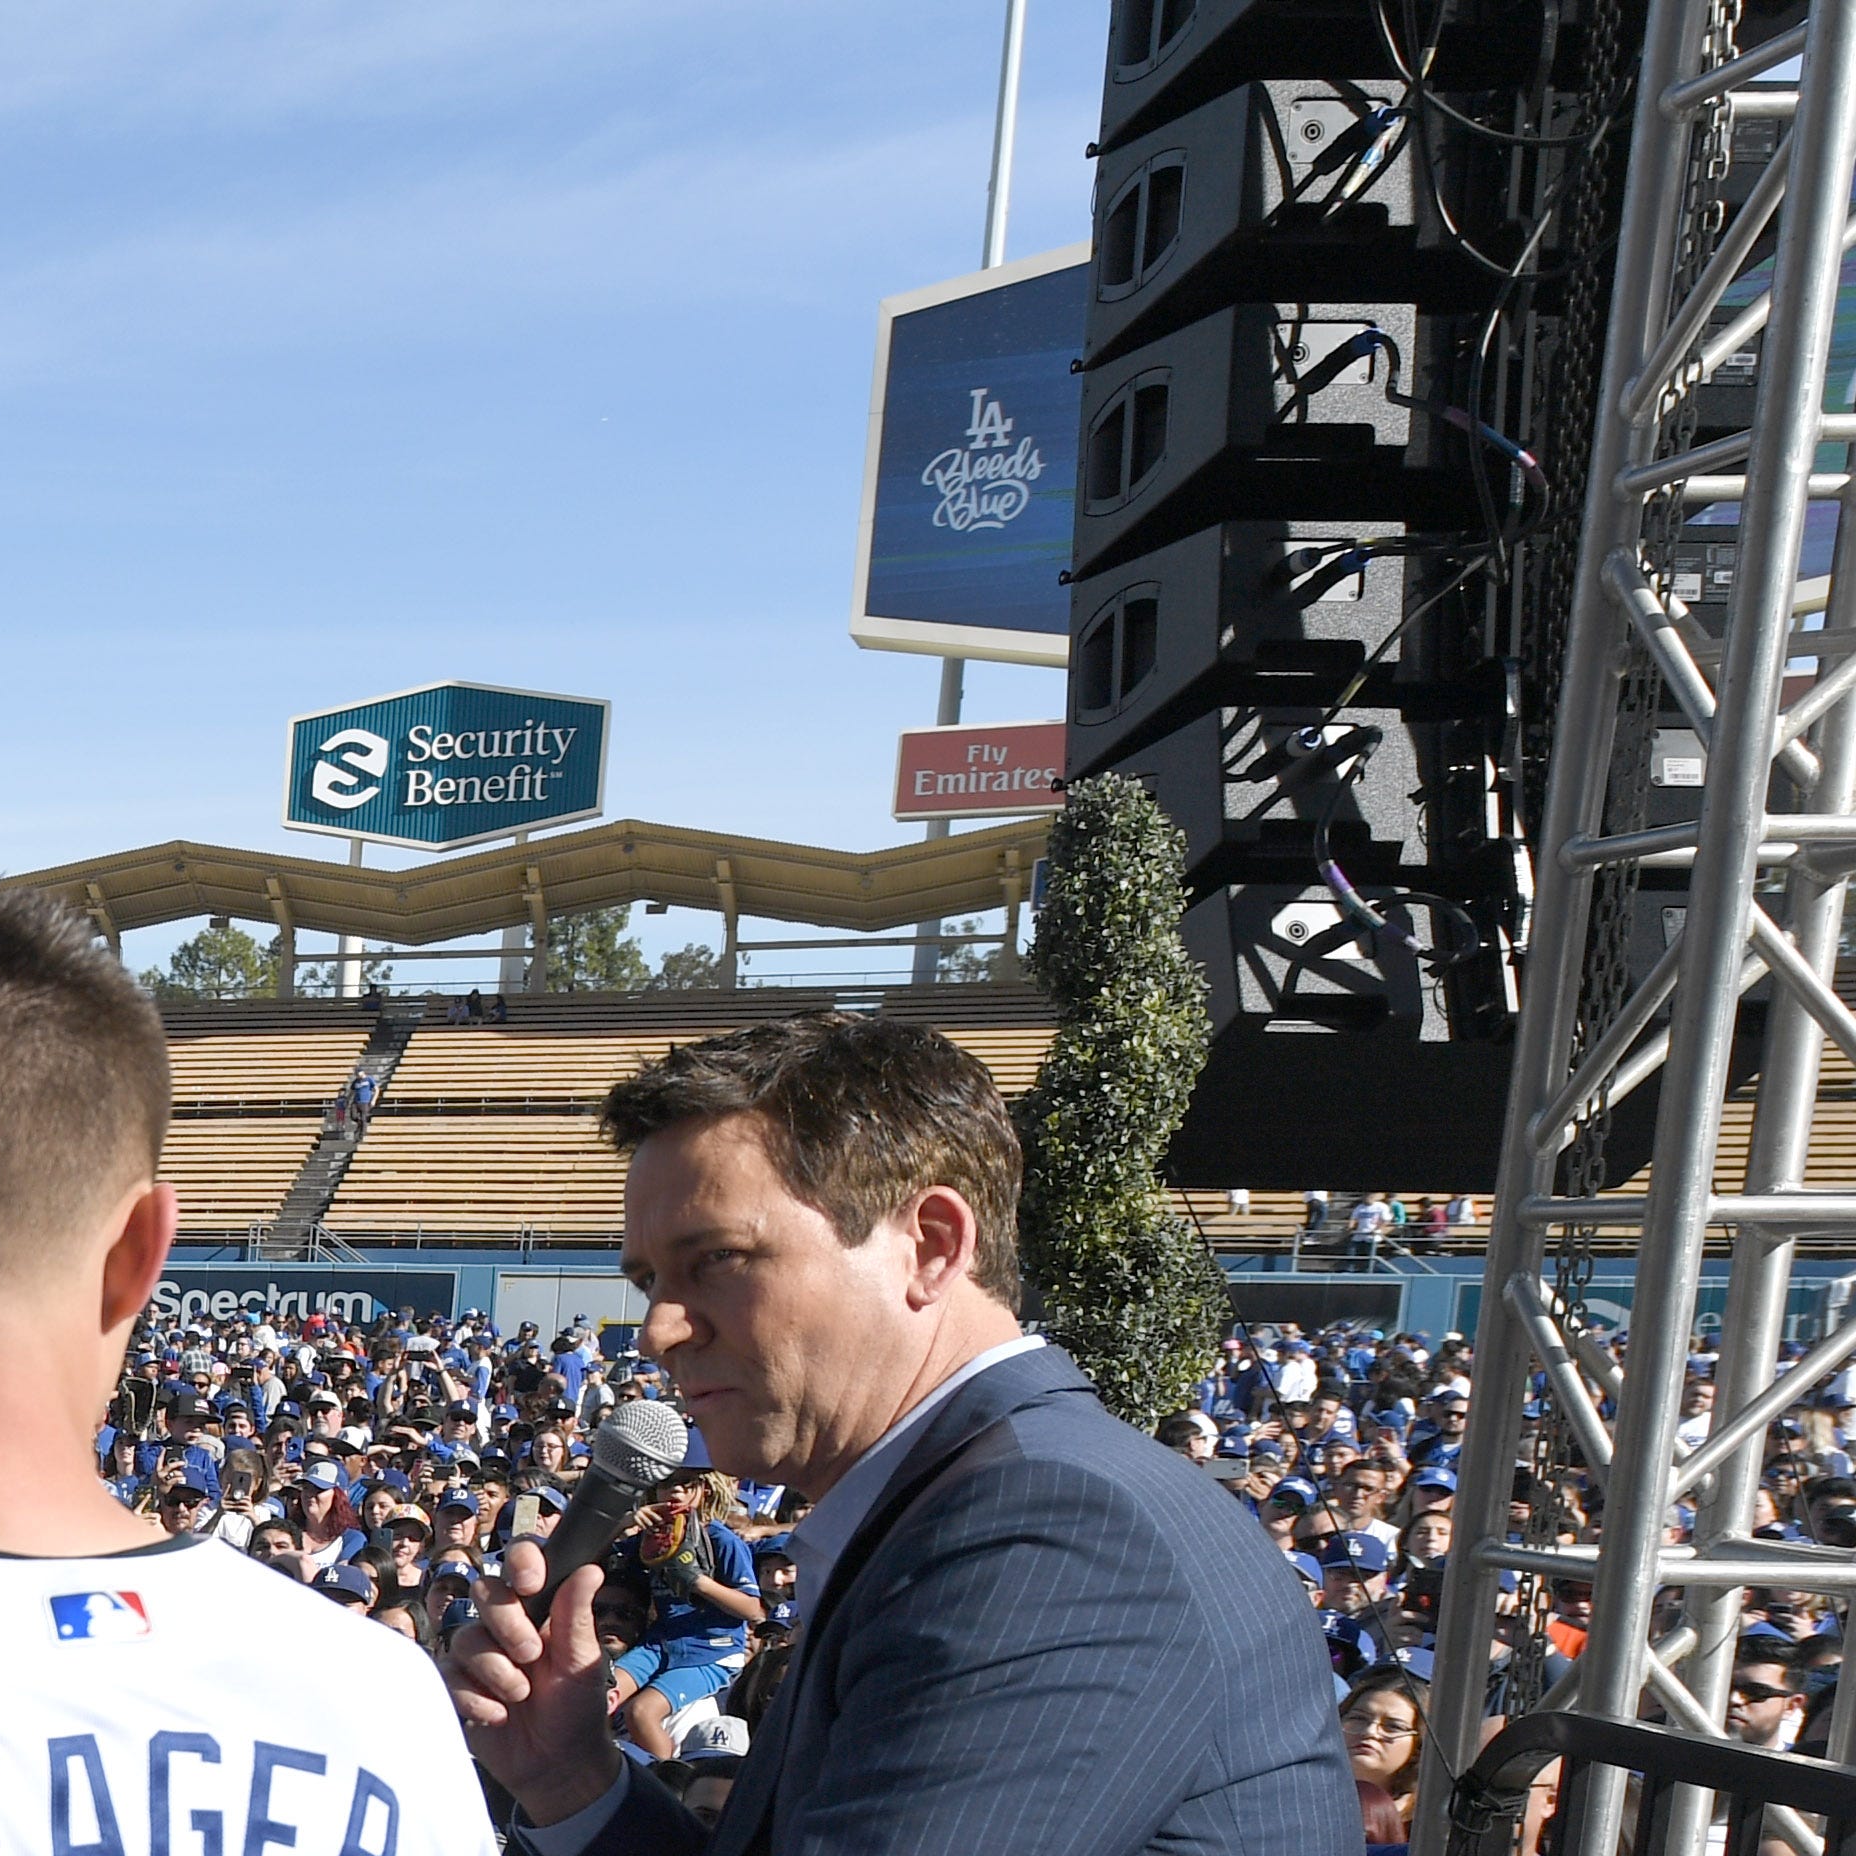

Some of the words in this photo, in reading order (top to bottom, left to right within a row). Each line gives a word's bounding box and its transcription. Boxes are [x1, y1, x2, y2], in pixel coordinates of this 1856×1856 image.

[965, 387, 1013, 450] LA
[921, 436, 1046, 494] Bleeds
[933, 479, 1030, 531] Blue
[406, 718, 578, 765] Security
[967, 744, 1007, 765] Fly
[404, 764, 549, 806] Benefit
[914, 766, 1057, 796] Emirates
[153, 1280, 375, 1330] Spectrum
[452, 1489, 468, 1500] D
[1348, 1538, 1363, 1556] LA
[324, 1567, 340, 1583] LA
